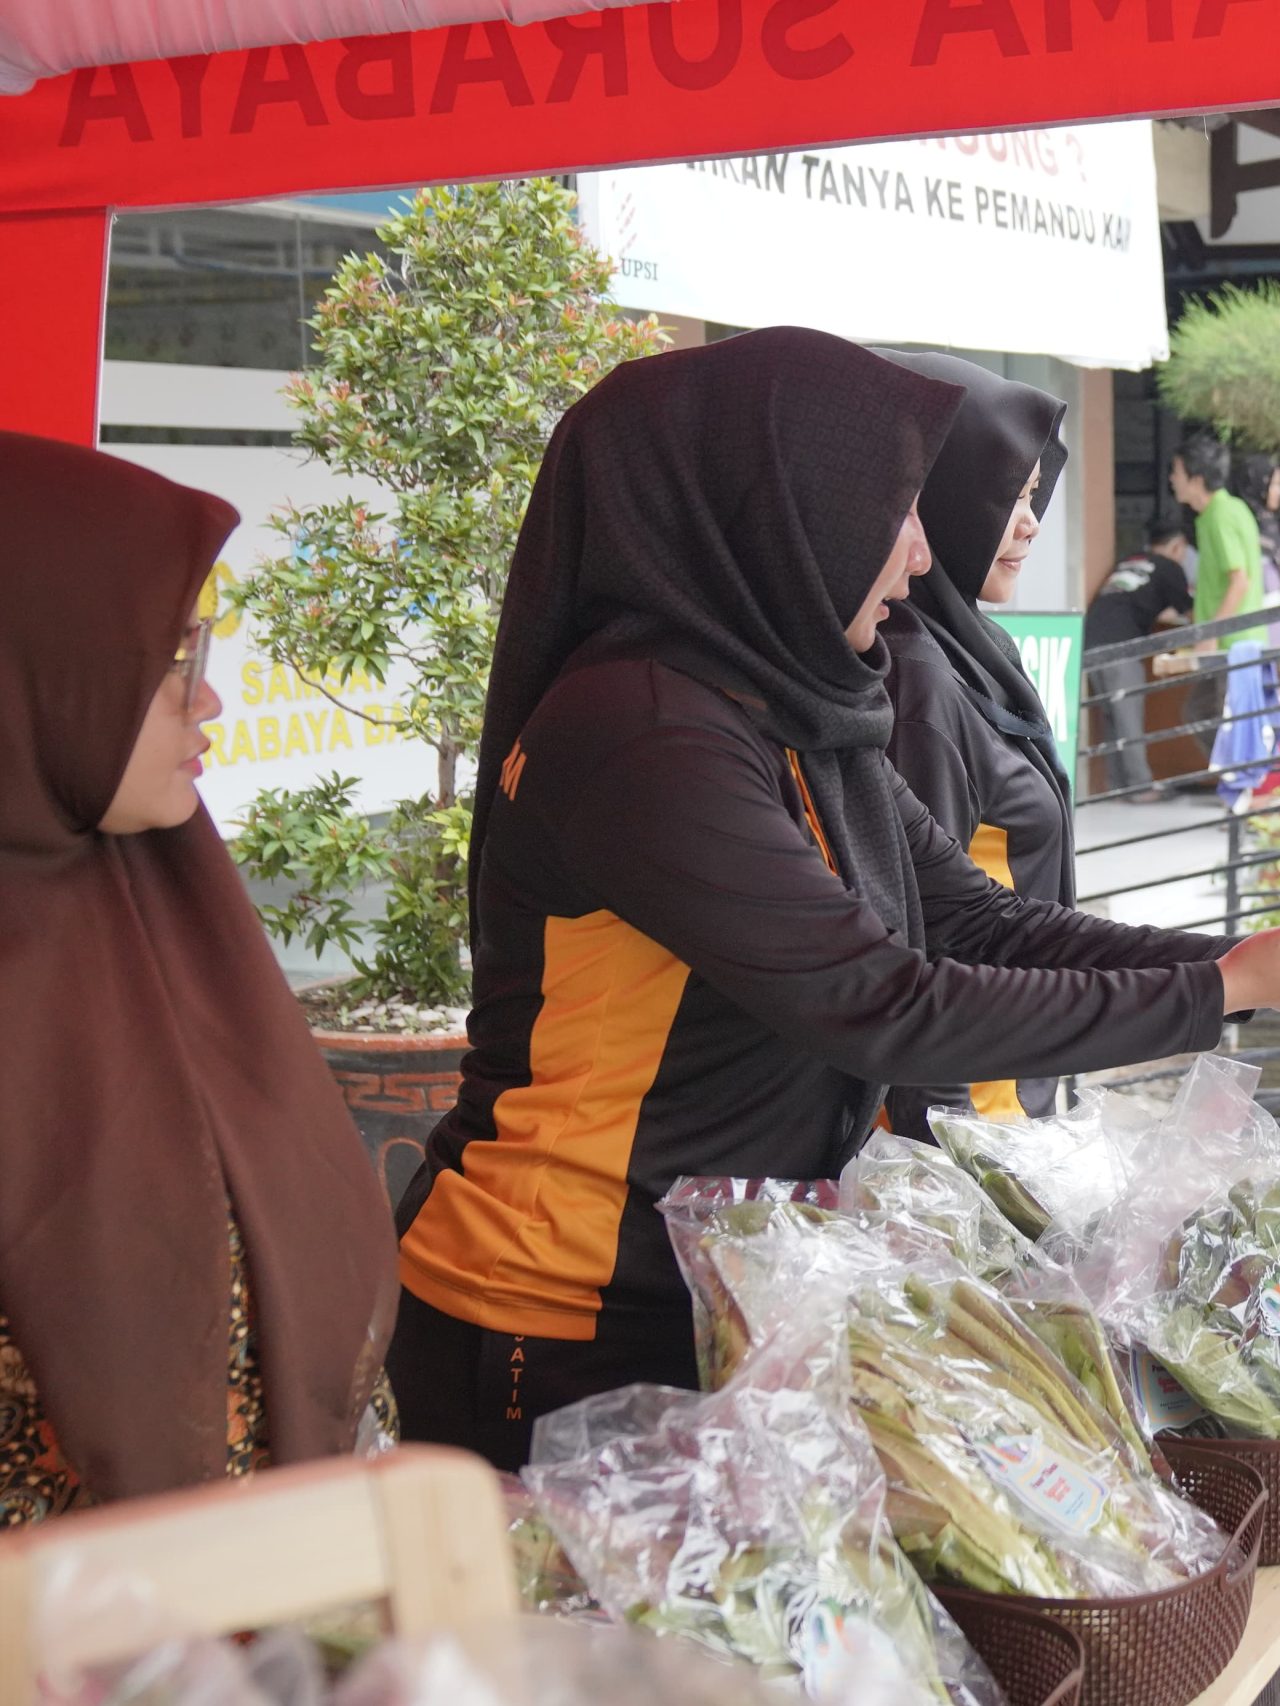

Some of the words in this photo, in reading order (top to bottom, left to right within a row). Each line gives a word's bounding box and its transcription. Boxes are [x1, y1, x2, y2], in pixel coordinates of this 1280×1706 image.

[801, 154, 915, 214] TANYA
[924, 175, 965, 222] KE
[974, 185, 1096, 245] PEMANDU
[1012, 634, 1072, 743] SIK
